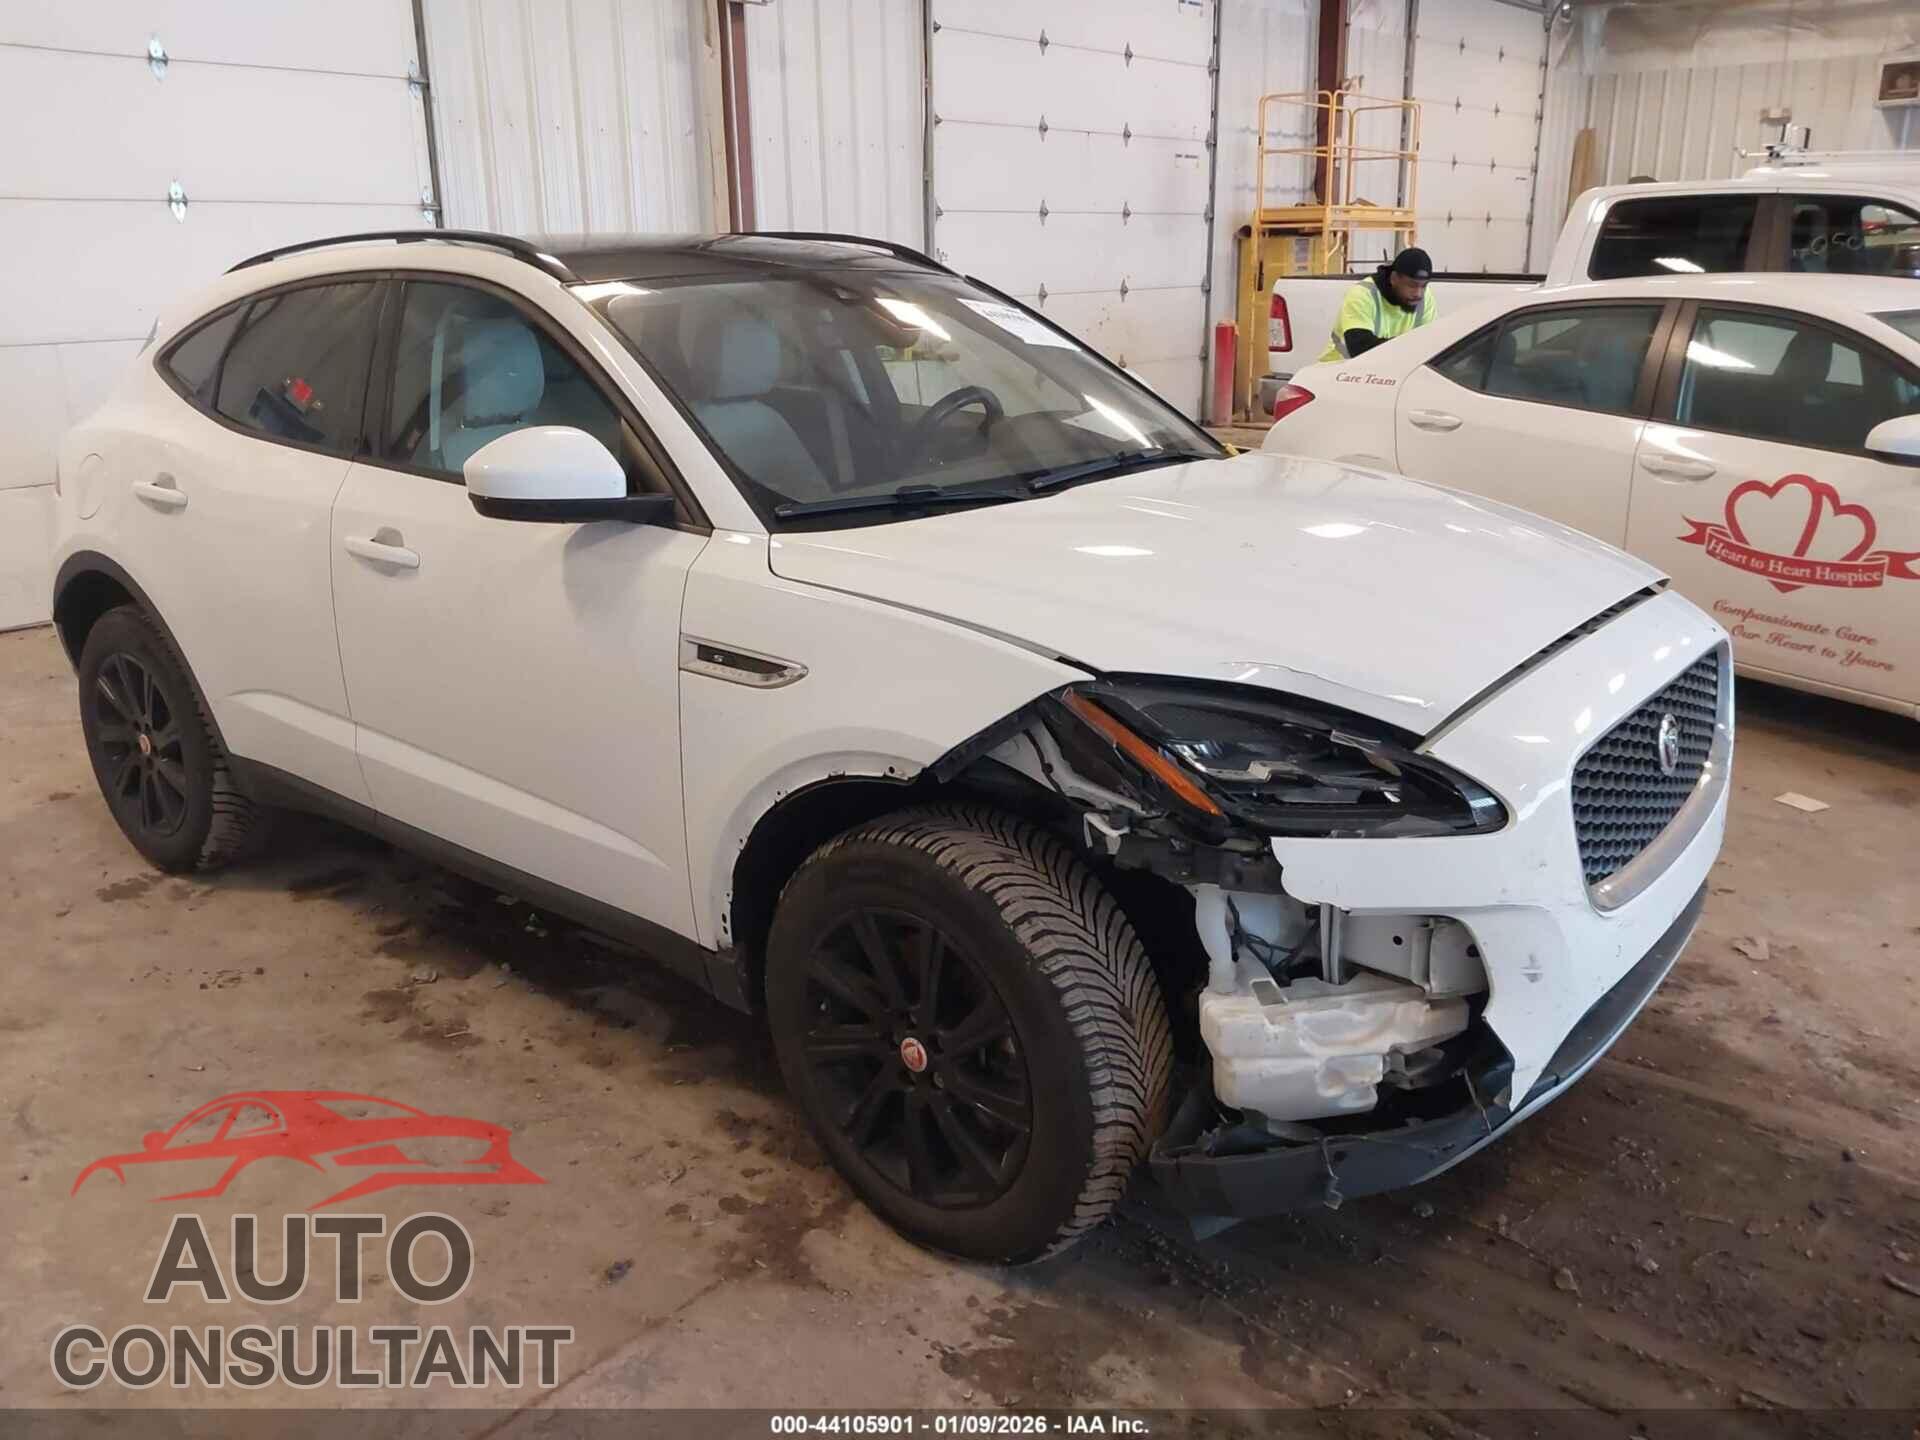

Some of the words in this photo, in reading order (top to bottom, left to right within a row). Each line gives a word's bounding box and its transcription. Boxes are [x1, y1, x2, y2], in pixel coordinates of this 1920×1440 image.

[1336, 372, 1362, 383] Care
[1365, 373, 1396, 386] Team
[1709, 538, 1746, 565] Heart
[1751, 557, 1764, 570] to
[1768, 558, 1810, 579] Heart
[1816, 565, 1882, 587] Hospice
[1713, 599, 1830, 635] Compassionate
[1835, 625, 1878, 646] Care
[1731, 624, 1761, 641] Our
[1765, 631, 1816, 655] Heart
[1821, 647, 1837, 659] to
